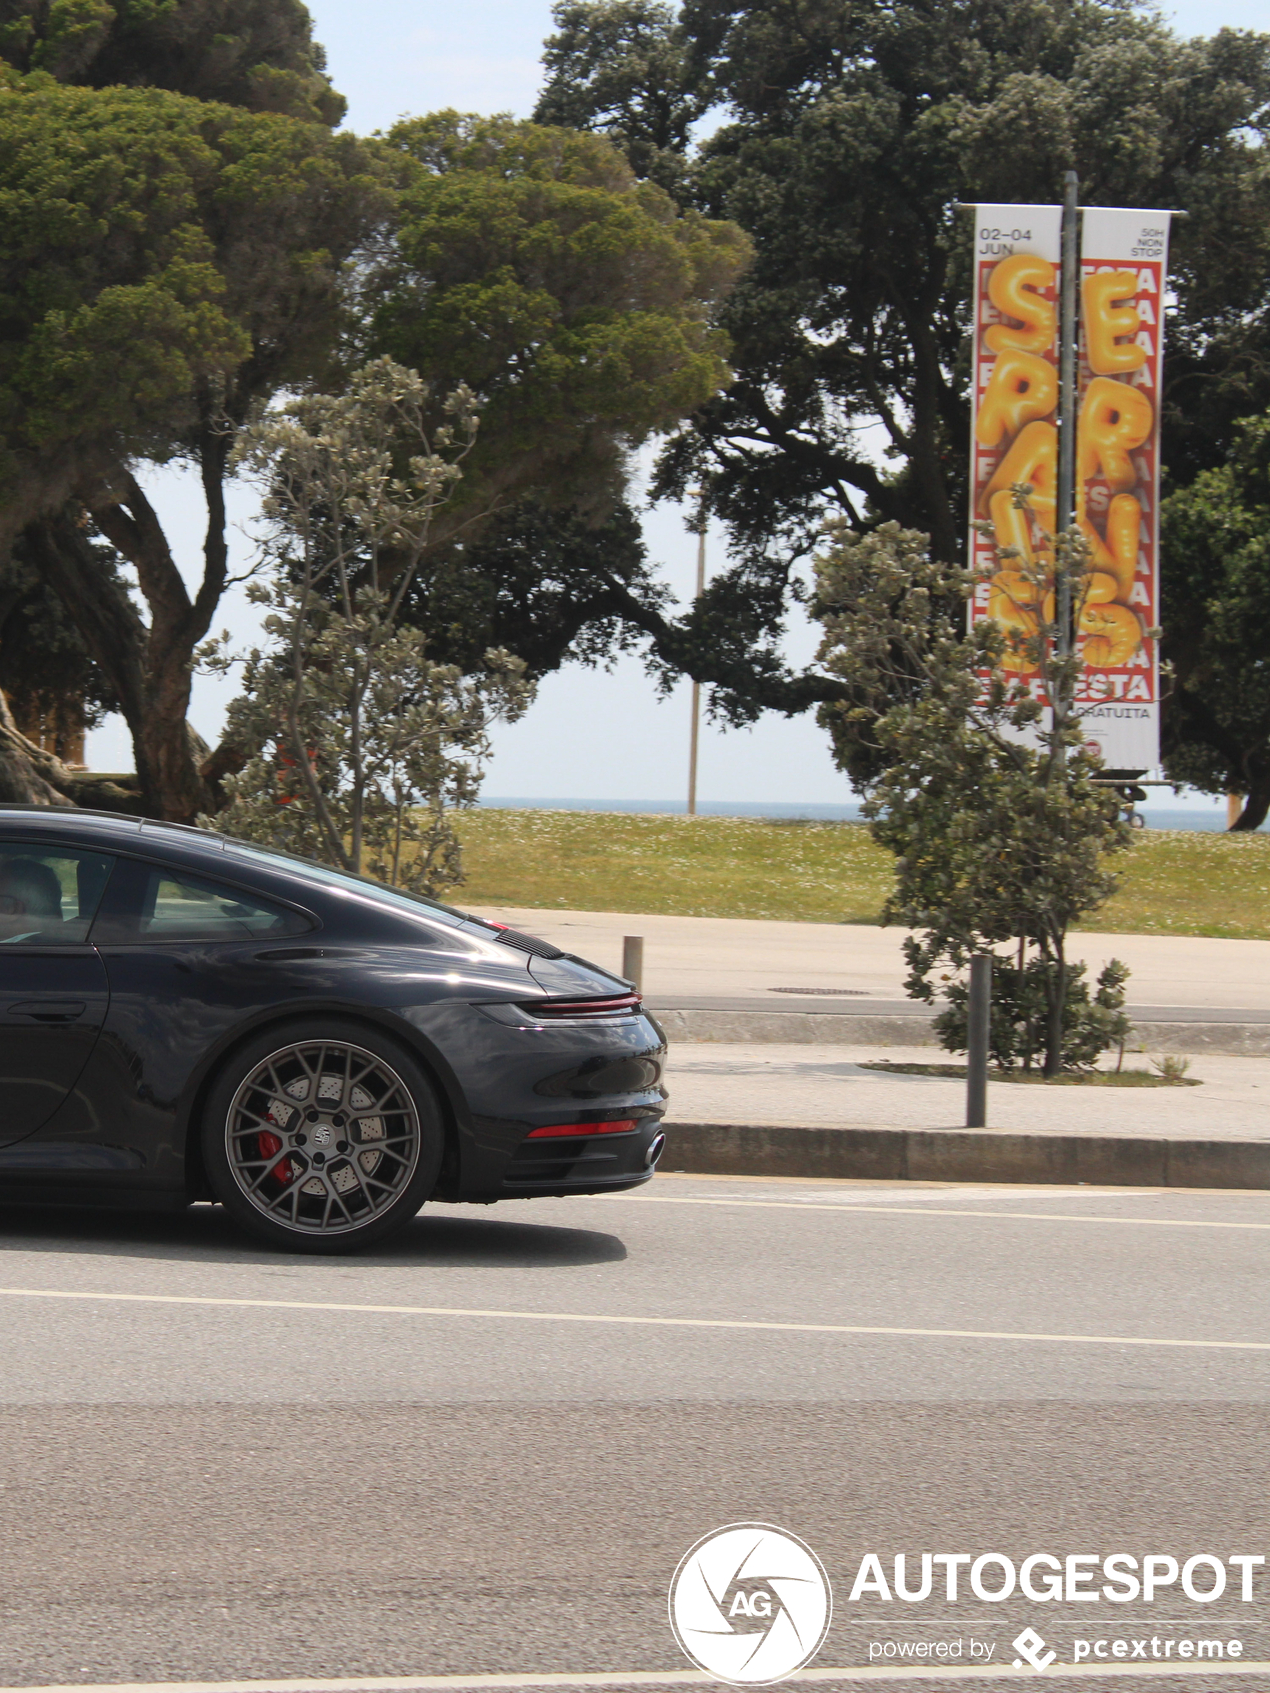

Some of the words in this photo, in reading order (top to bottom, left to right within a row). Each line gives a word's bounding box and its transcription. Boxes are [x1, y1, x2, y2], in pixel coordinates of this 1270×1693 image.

[1141, 228, 1165, 238] 50H
[1137, 238, 1163, 248] NON
[979, 243, 1014, 255] JUN
[1131, 247, 1163, 257] STOP
